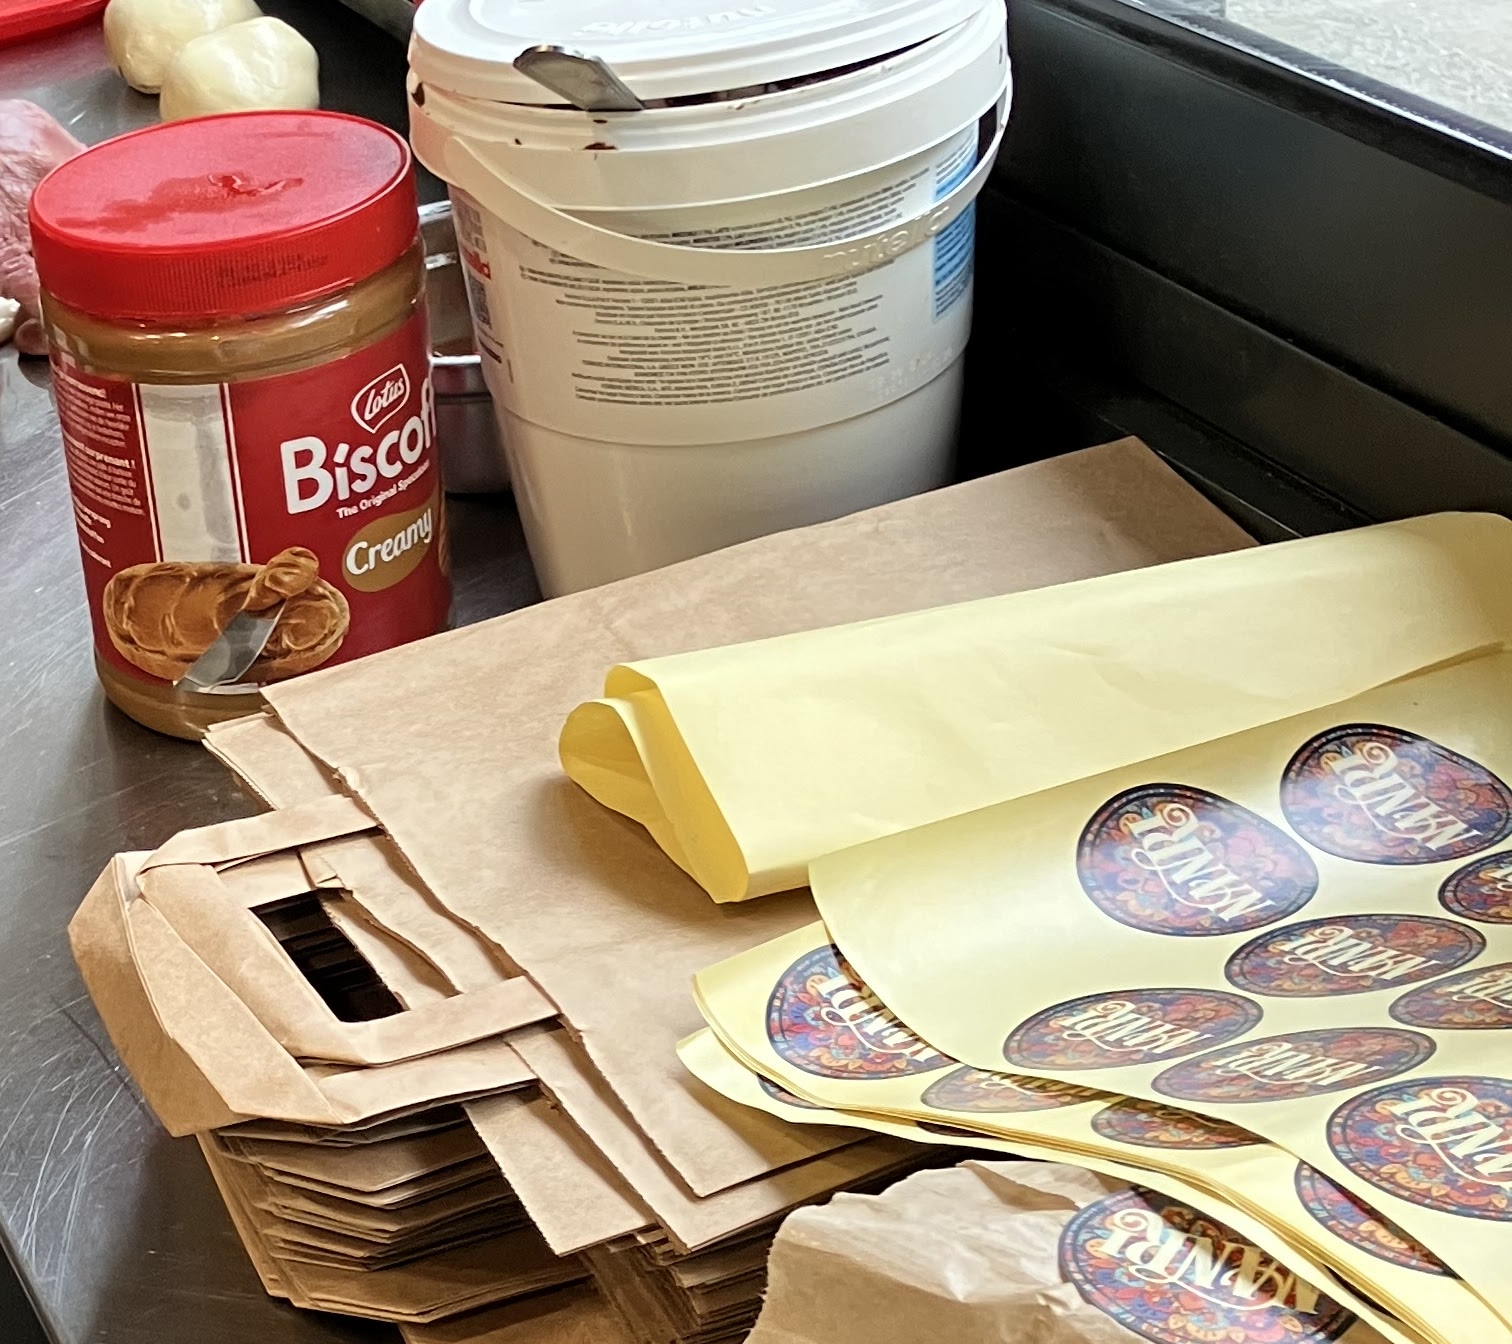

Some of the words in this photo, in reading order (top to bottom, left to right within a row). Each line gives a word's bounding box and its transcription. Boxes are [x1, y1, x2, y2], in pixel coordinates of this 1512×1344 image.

[364, 377, 405, 421] Lotus
[336, 506, 359, 519] The
[359, 484, 399, 510] Original
[346, 507, 433, 575] Creamy
[1331, 742, 1482, 851] NANRI
[1129, 803, 1277, 922] NANRI
[1282, 926, 1443, 981] NANRI
[1060, 1001, 1215, 1054] NANRI
